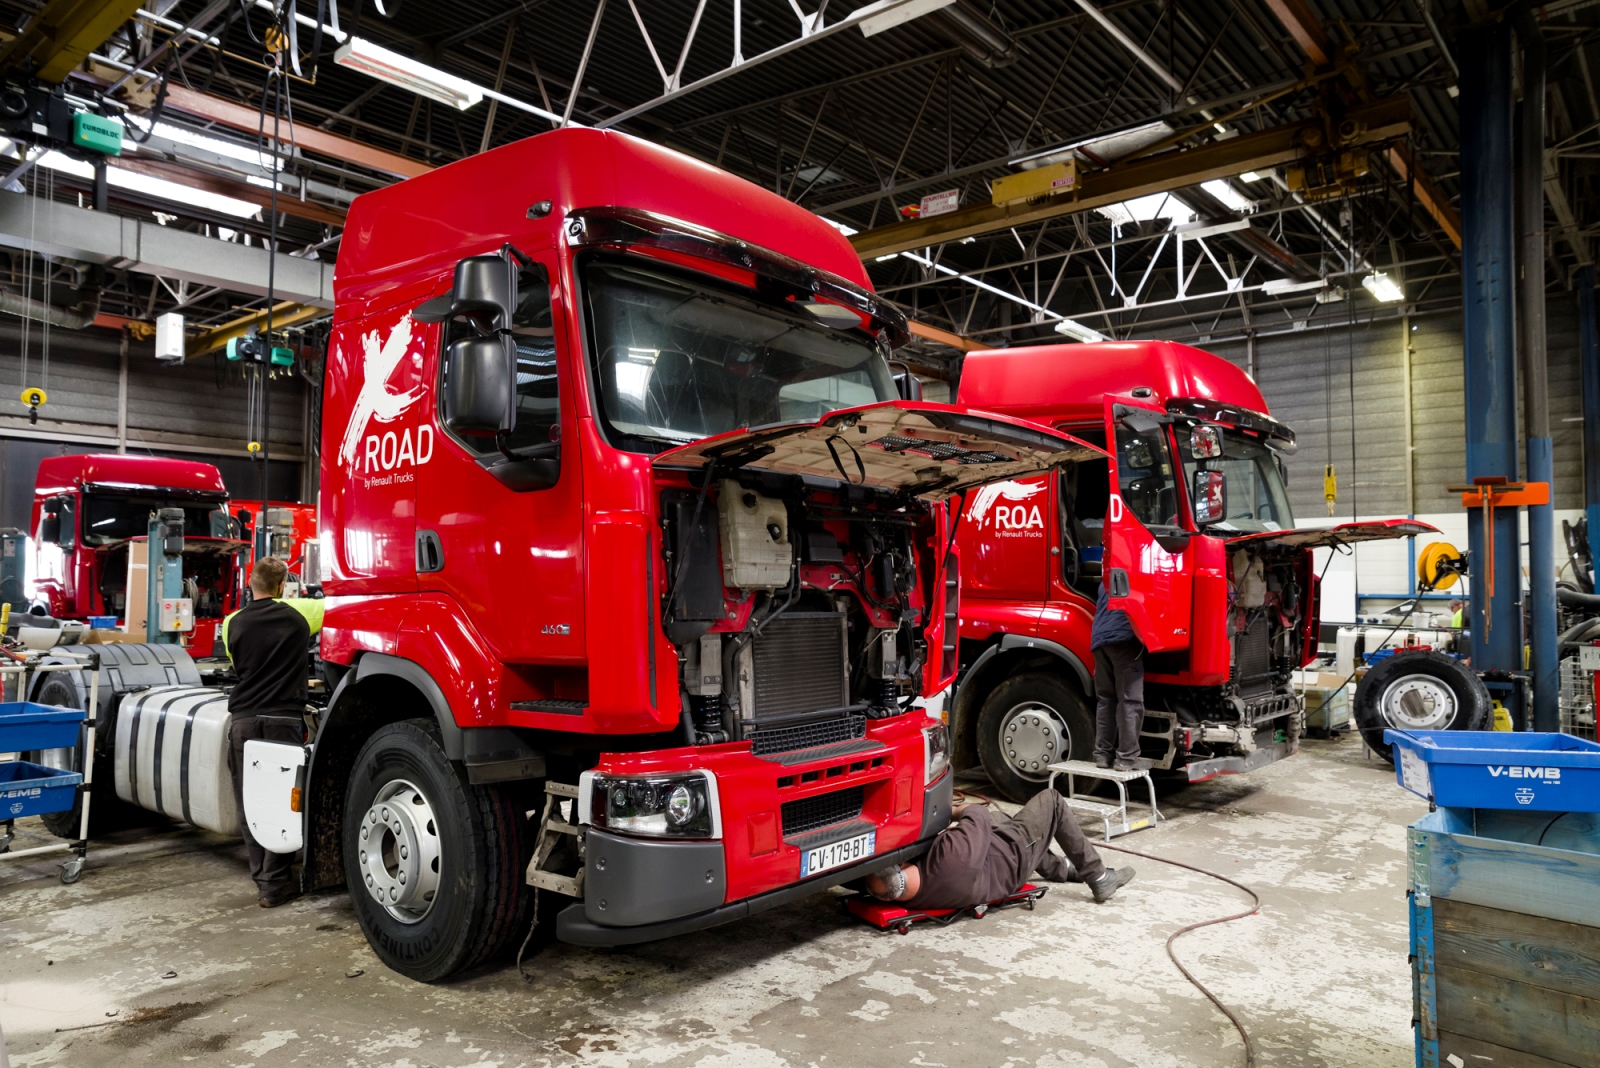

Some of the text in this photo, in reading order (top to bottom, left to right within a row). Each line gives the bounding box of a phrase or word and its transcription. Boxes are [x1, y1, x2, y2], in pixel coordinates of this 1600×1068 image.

[82, 122, 120, 139] EUROBLOC
[365, 424, 434, 474] ROAD
[364, 472, 414, 490] by Renault Trucks
[995, 530, 1043, 539] by Renault Trucks
[1487, 765, 1561, 779] V-EMB
